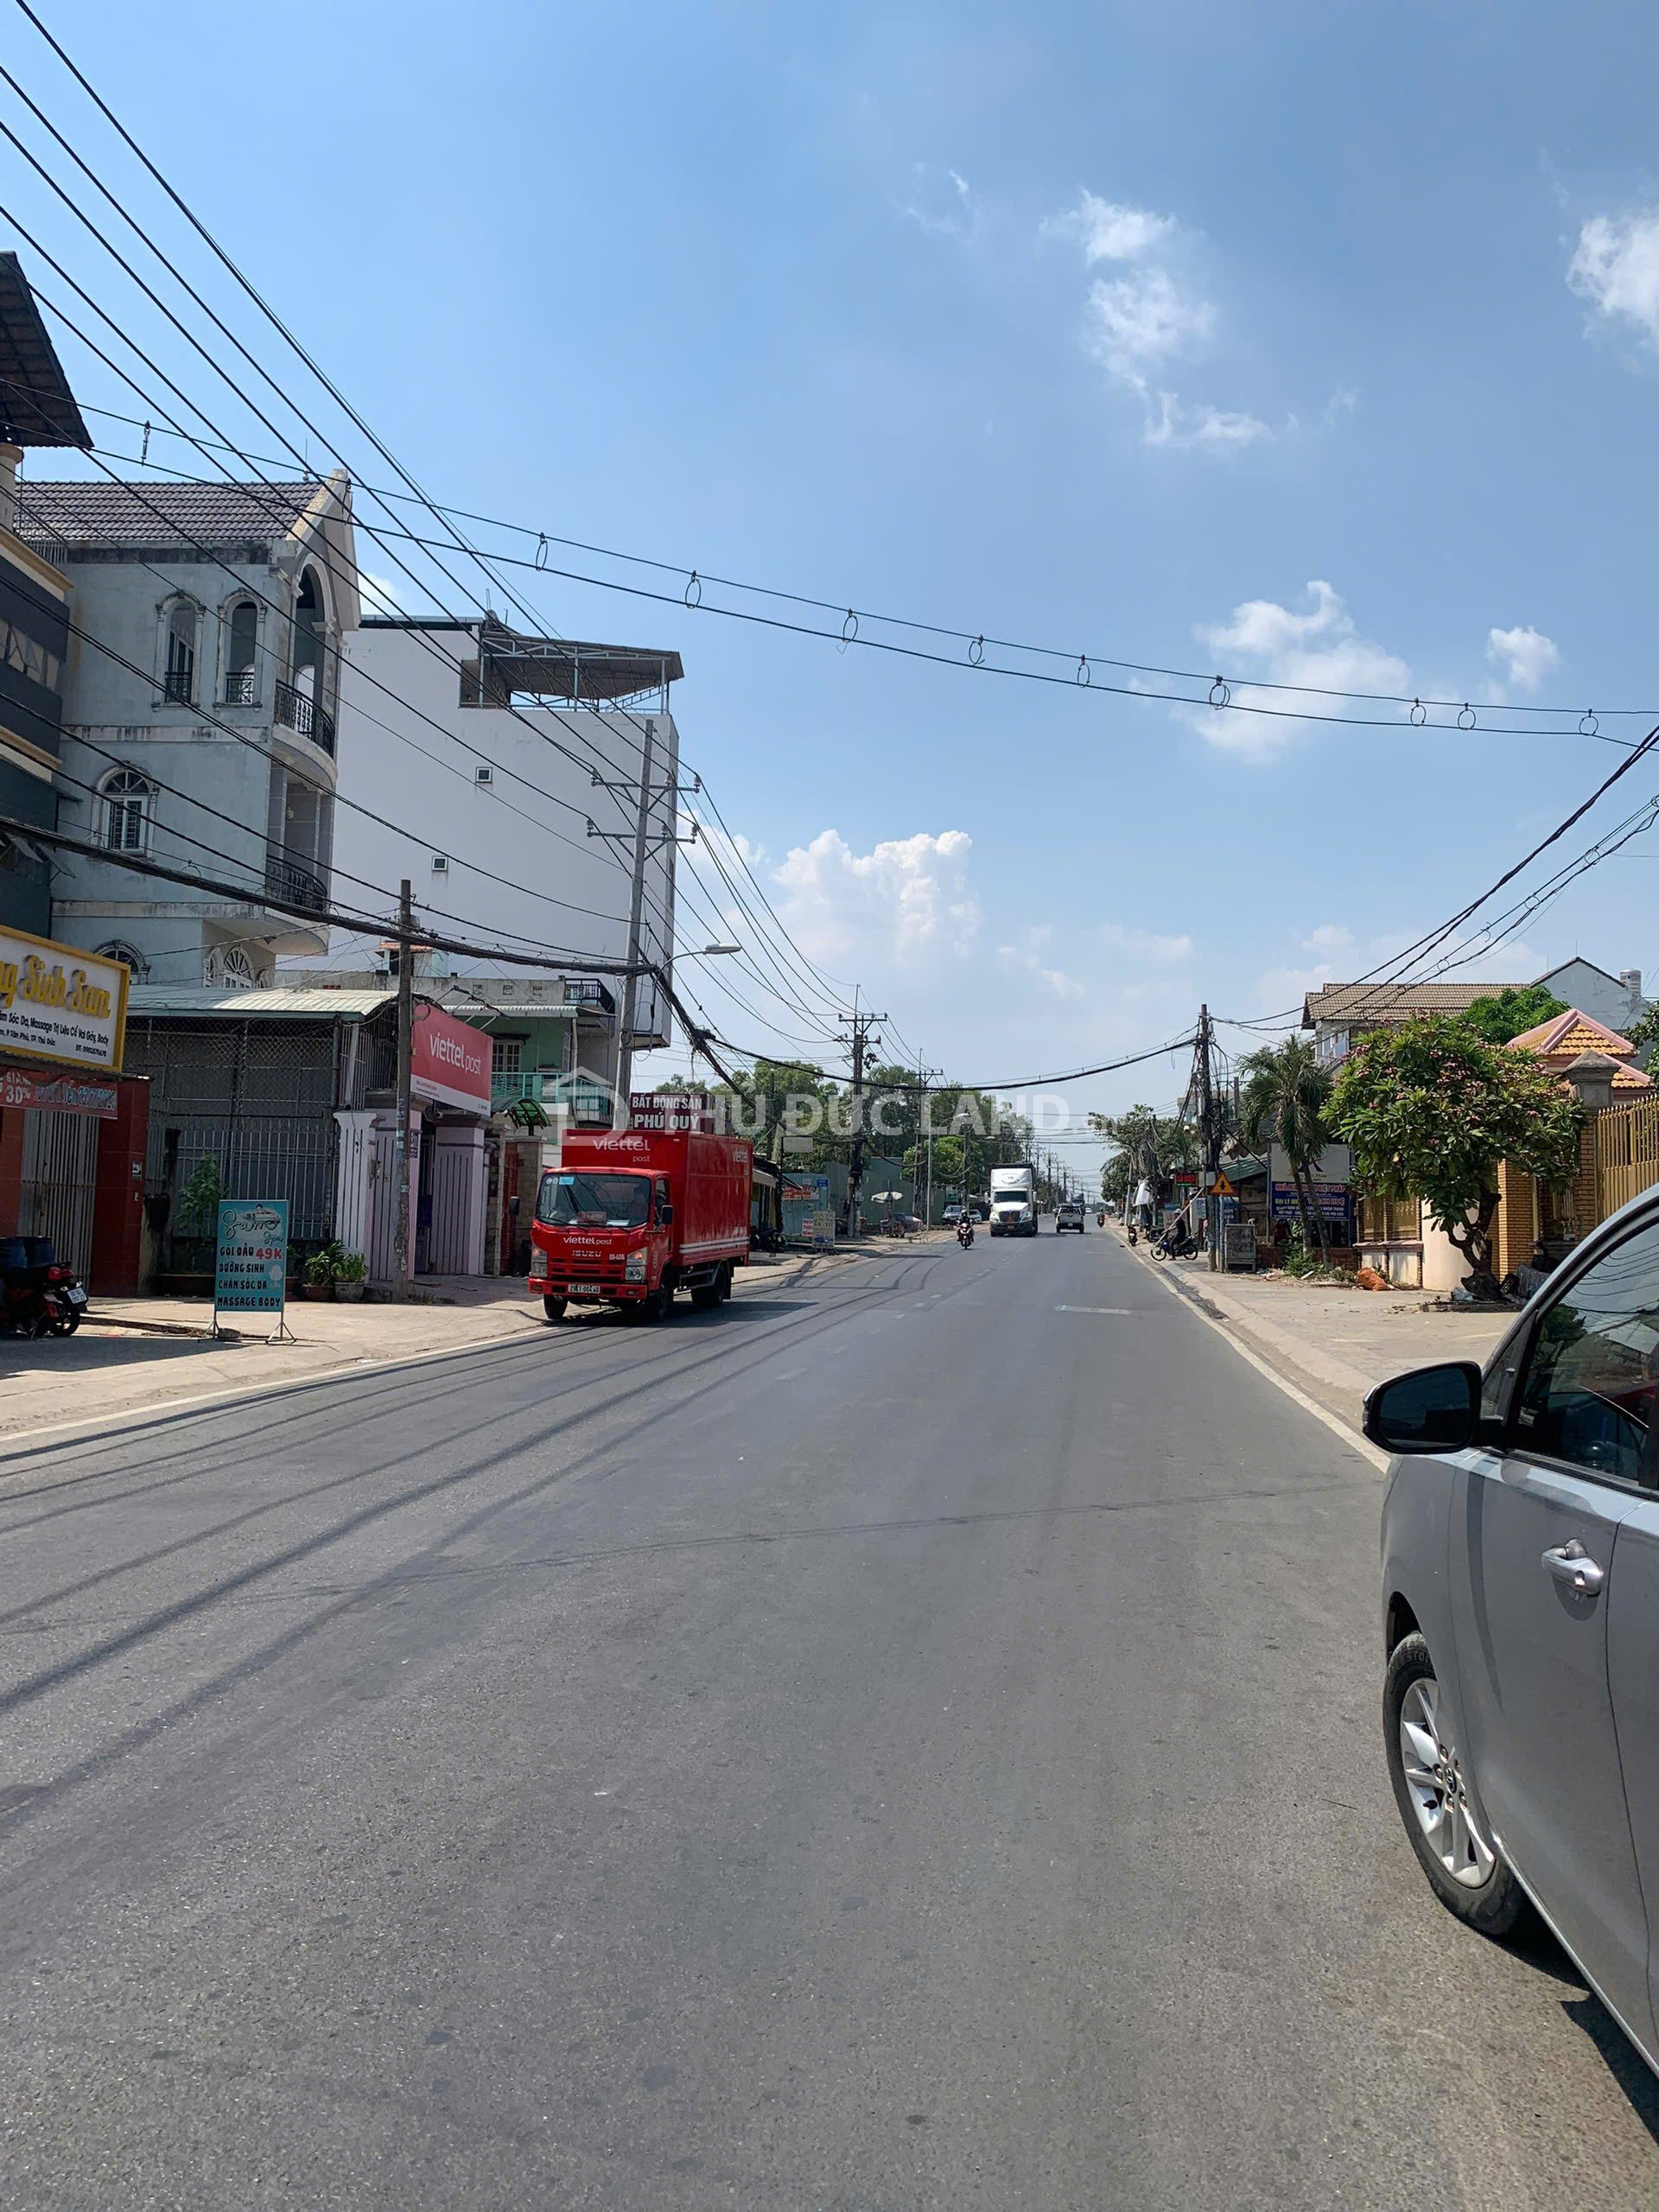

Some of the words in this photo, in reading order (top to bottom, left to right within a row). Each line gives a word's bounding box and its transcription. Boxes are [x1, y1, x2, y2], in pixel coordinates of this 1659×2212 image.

[17, 954, 66, 1007] Sinh
[66, 969, 111, 1018] Sam
[9, 1013, 19, 1025] Sóc
[30, 1017, 52, 1033] Massage
[429, 1033, 465, 1069] viettel
[465, 1056, 481, 1075] post
[632, 1094, 651, 1108] BẤT
[653, 1095, 679, 1111] ĐỘNG
[681, 1095, 702, 1109] SẢN
[634, 1112, 664, 1128] PHÚ
[669, 1113, 699, 1129] QUÝ
[593, 1138, 650, 1151] viettel
[256, 1248, 282, 1259] 49K
[246, 1263, 264, 1273] SINH
[217, 1296, 256, 1306] MASSAGE
[258, 1297, 281, 1306] BODY
